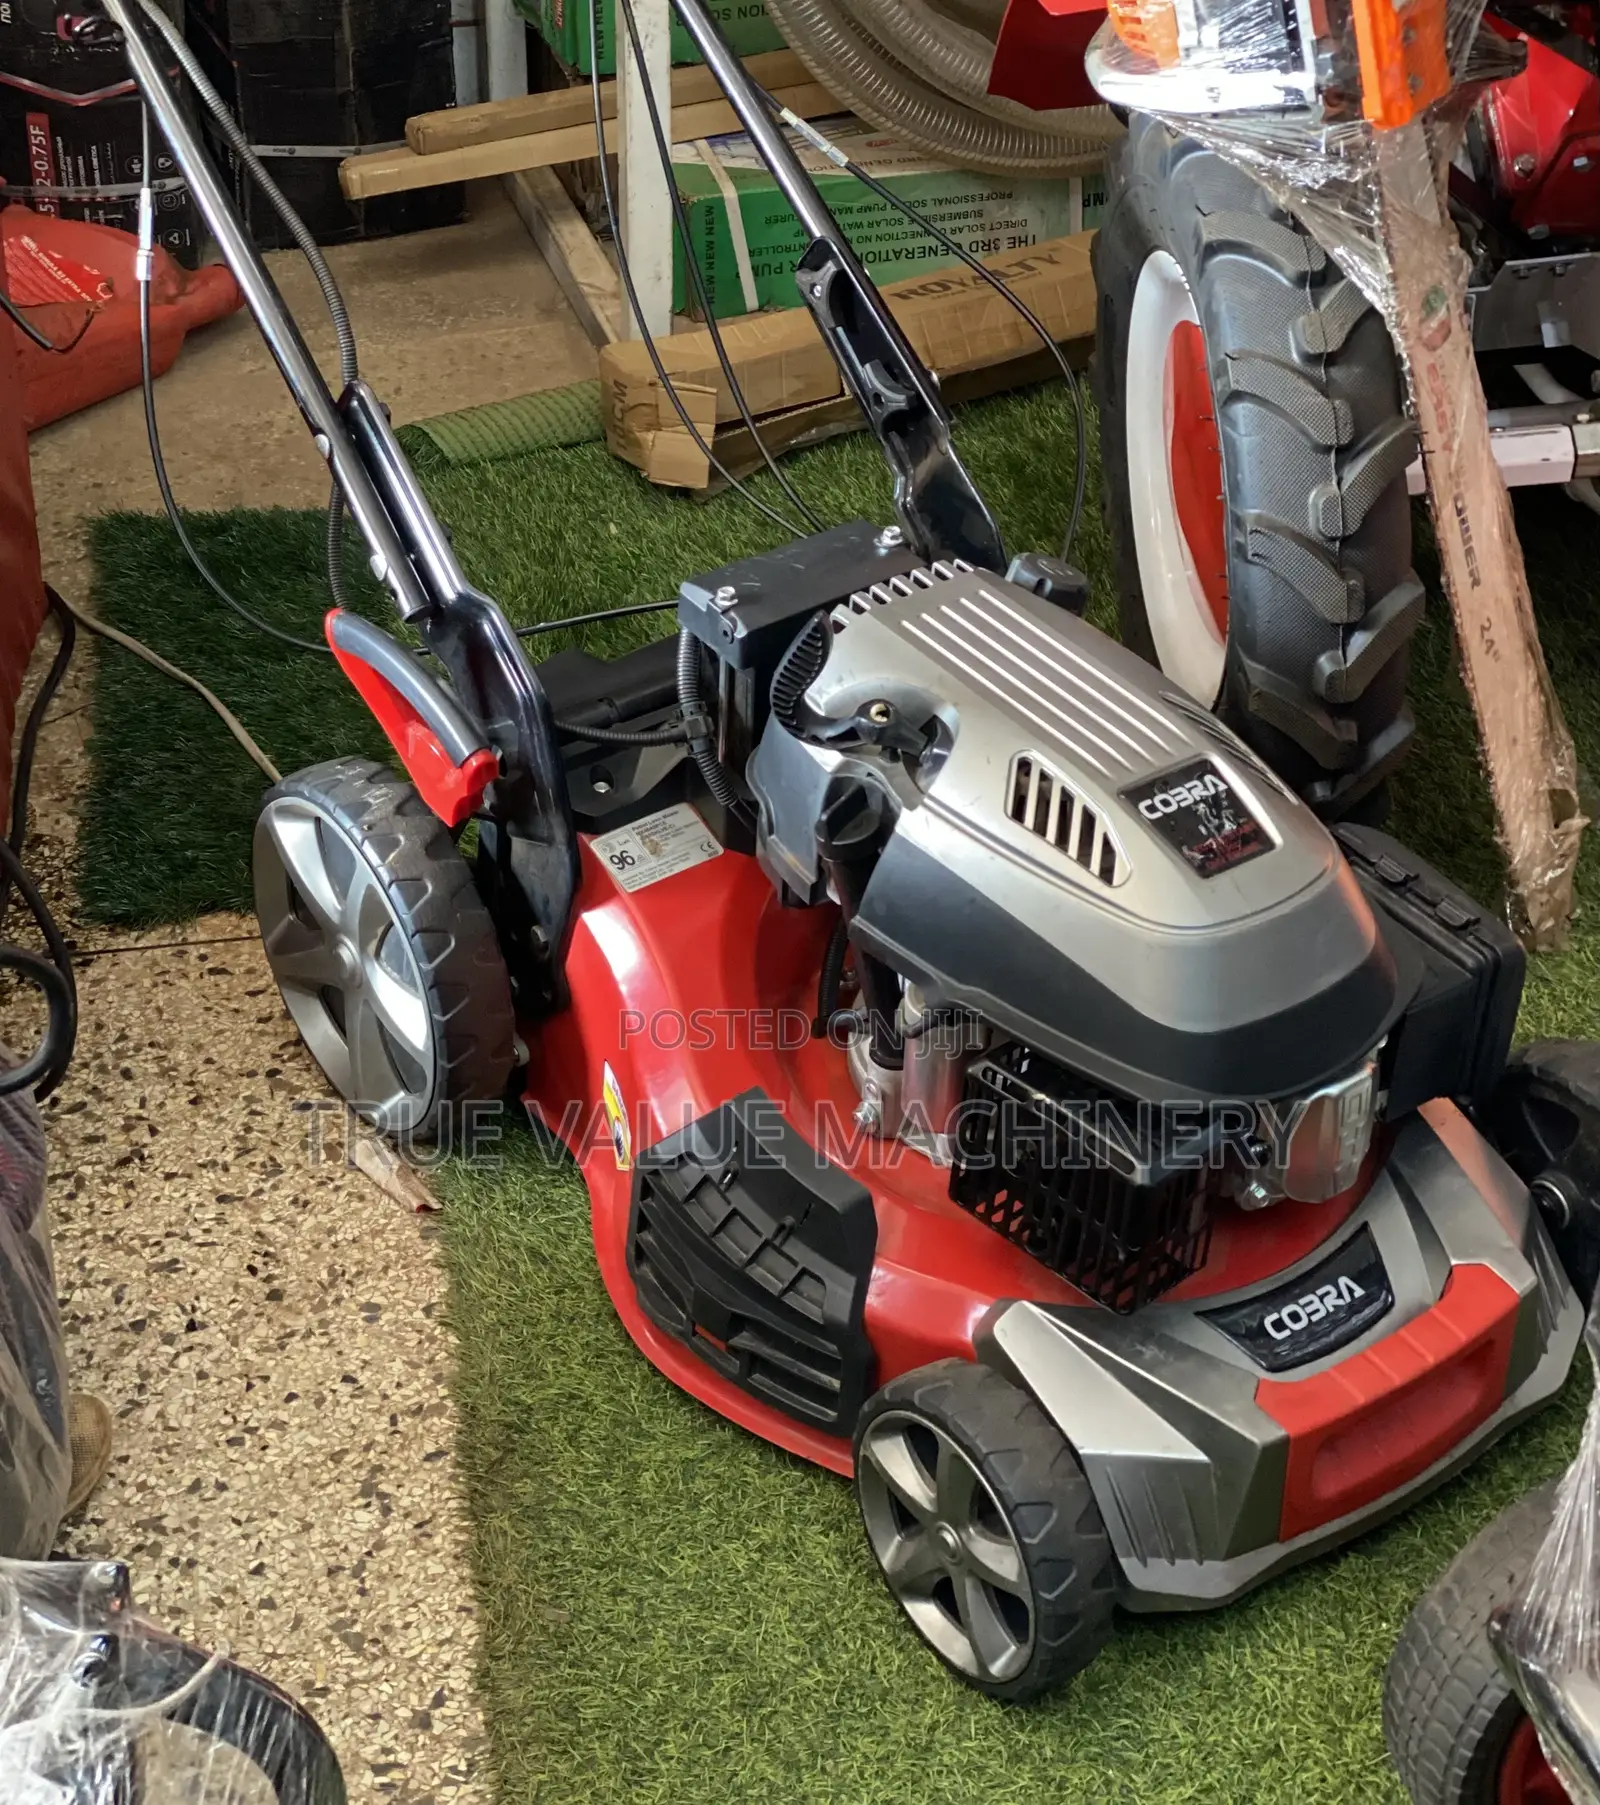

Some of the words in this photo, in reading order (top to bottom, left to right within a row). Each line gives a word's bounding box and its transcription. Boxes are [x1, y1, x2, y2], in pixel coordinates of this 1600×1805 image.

[931, 191, 1013, 206] PROFESSIONAL
[856, 203, 887, 215] PUMP
[704, 205, 715, 236] NEW
[867, 217, 904, 229] SOLAR
[989, 218, 1027, 232] DIRECT
[950, 223, 986, 235] SOLAR
[856, 235, 873, 245] NO
[969, 238, 1000, 253] 3RD
[1007, 234, 1036, 250] THE
[704, 240, 715, 271] NEW
[1138, 774, 1229, 820] COBRA
[609, 850, 636, 870] 96
[1264, 1275, 1366, 1340] COBRA
